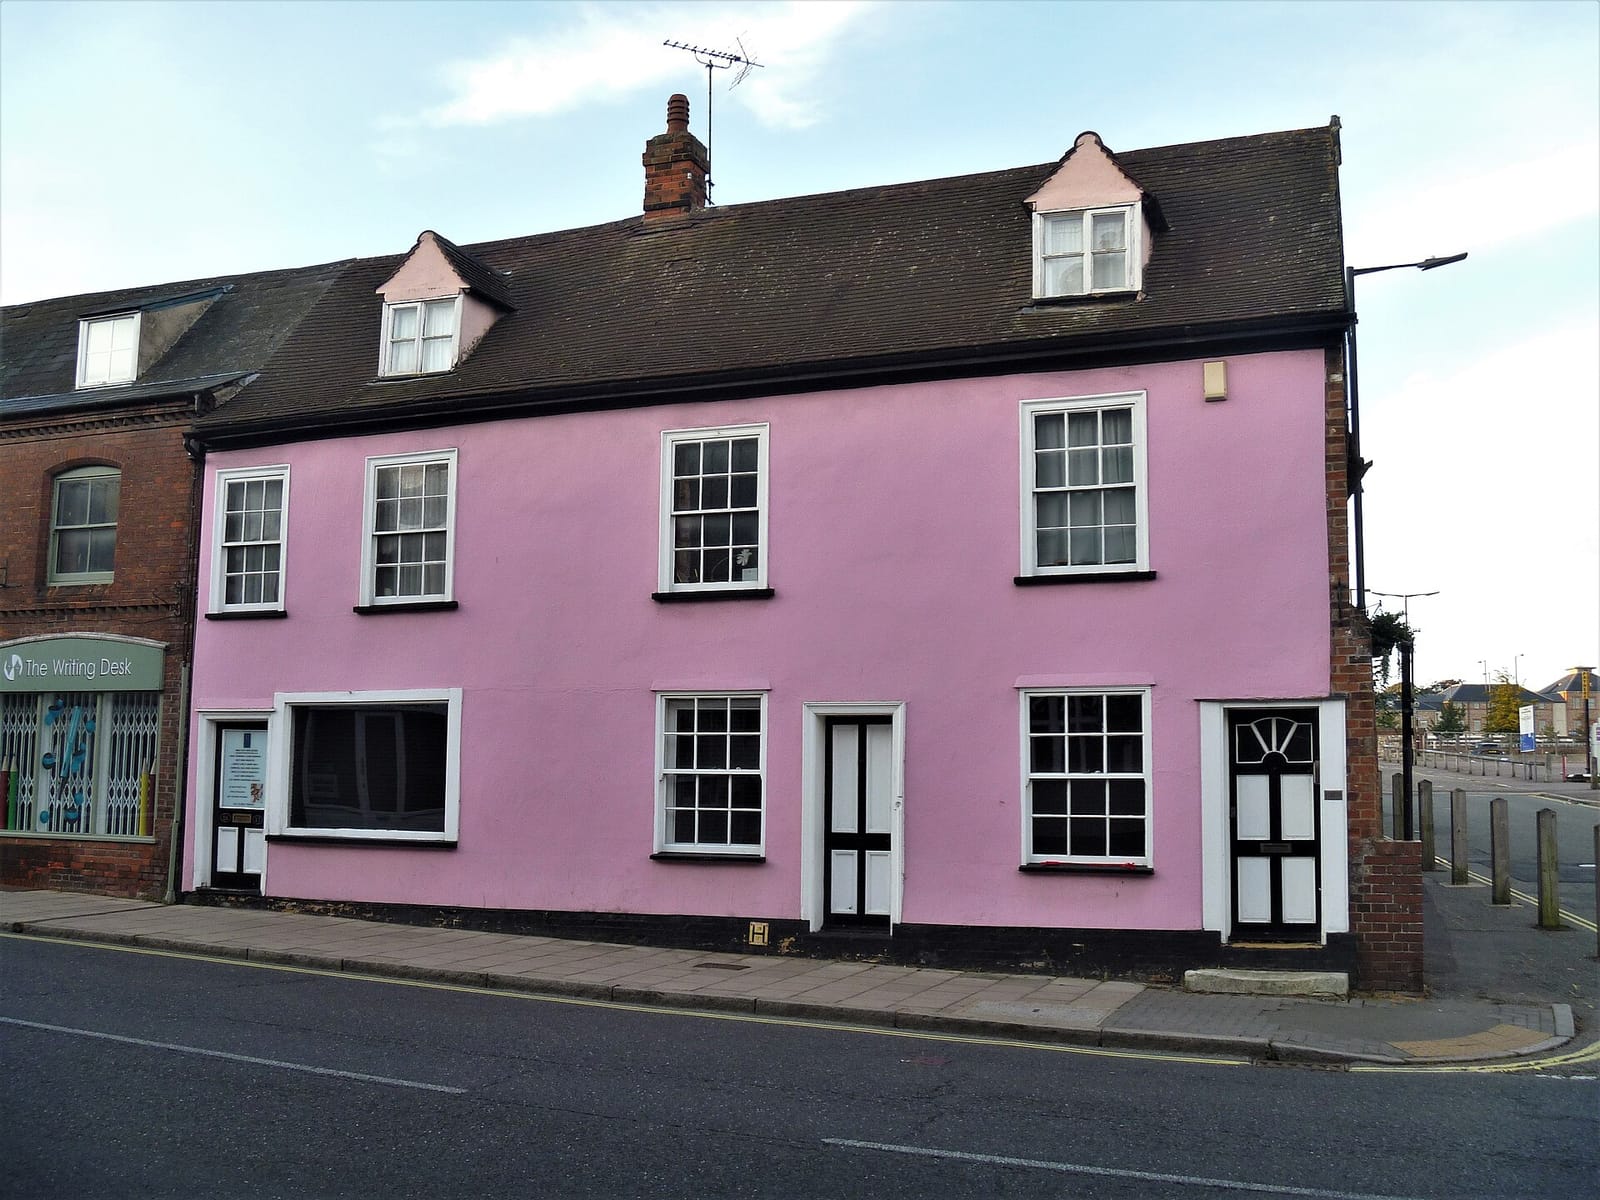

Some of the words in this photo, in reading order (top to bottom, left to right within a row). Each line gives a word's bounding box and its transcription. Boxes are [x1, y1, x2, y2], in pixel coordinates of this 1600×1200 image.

[26, 659, 48, 676] The
[53, 658, 96, 680] Writing
[100, 657, 132, 676] Desk
[751, 923, 766, 944] H
